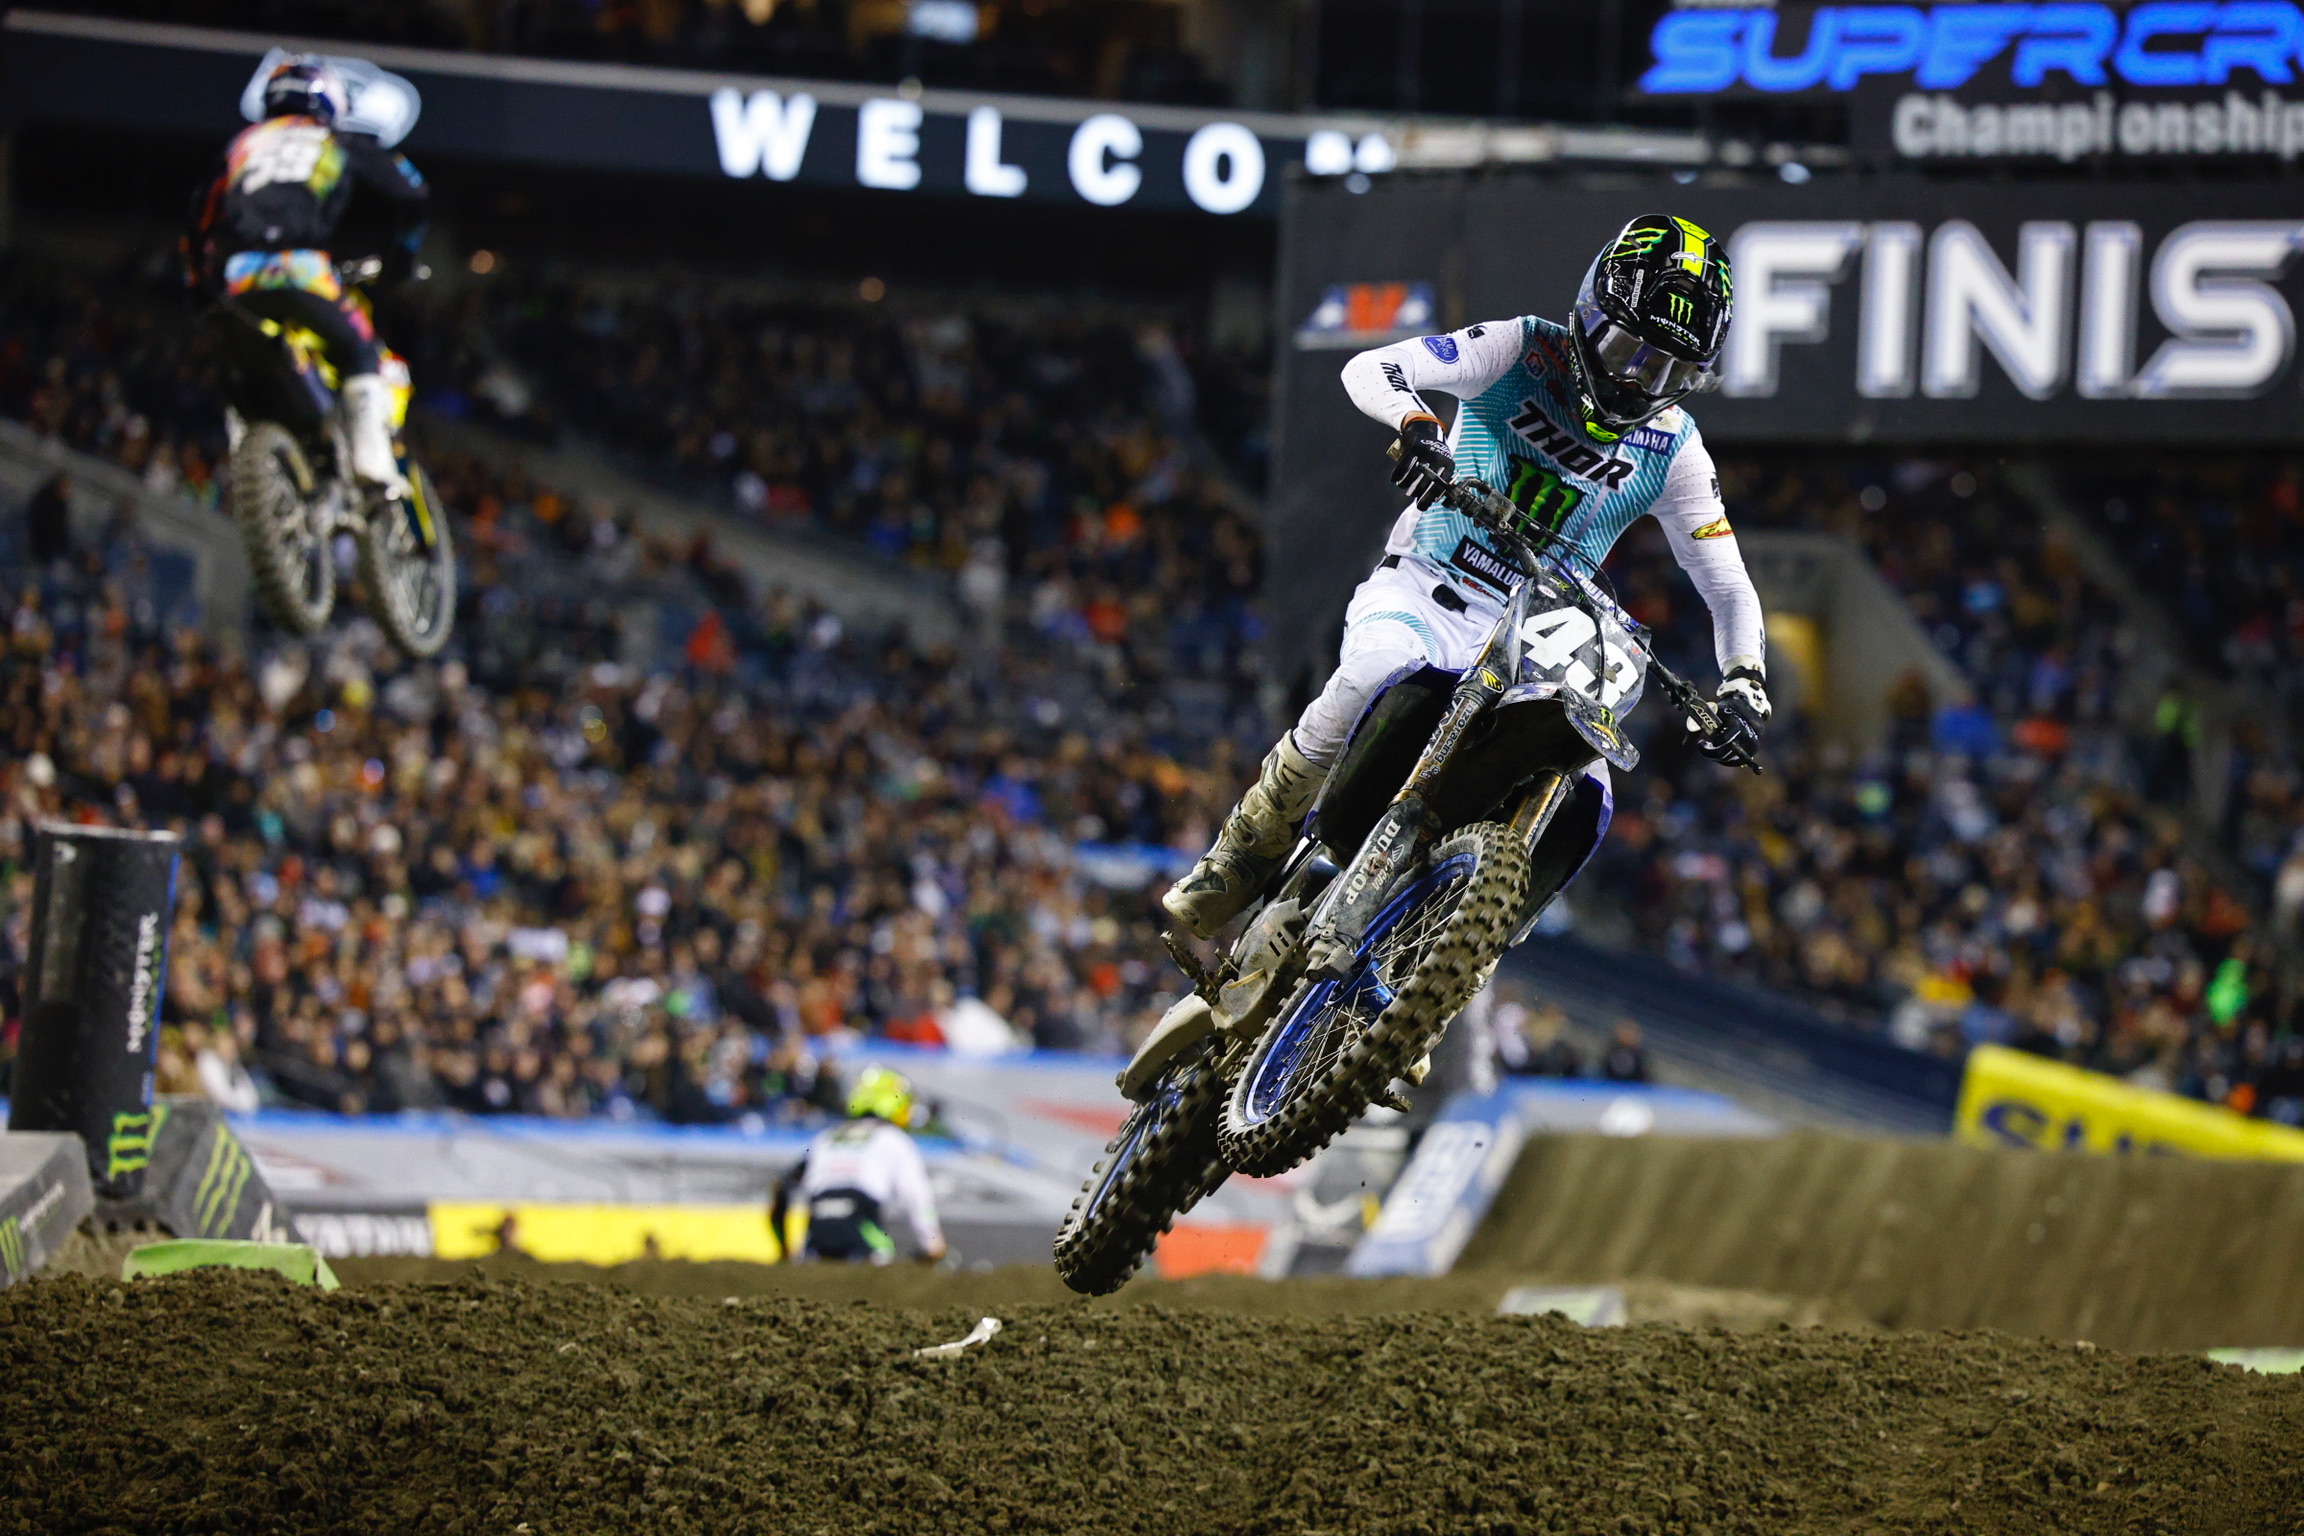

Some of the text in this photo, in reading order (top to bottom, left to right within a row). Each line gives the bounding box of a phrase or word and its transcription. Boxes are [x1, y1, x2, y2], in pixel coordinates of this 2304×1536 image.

[1510, 400, 1634, 493] THOR
[1623, 429, 1670, 451] AMAHA
[1521, 606, 1640, 709] 43
[1690, 704, 1718, 731] ARC
[1346, 819, 1402, 905] DUNLOP
[1371, 856, 1401, 892] CCRA
